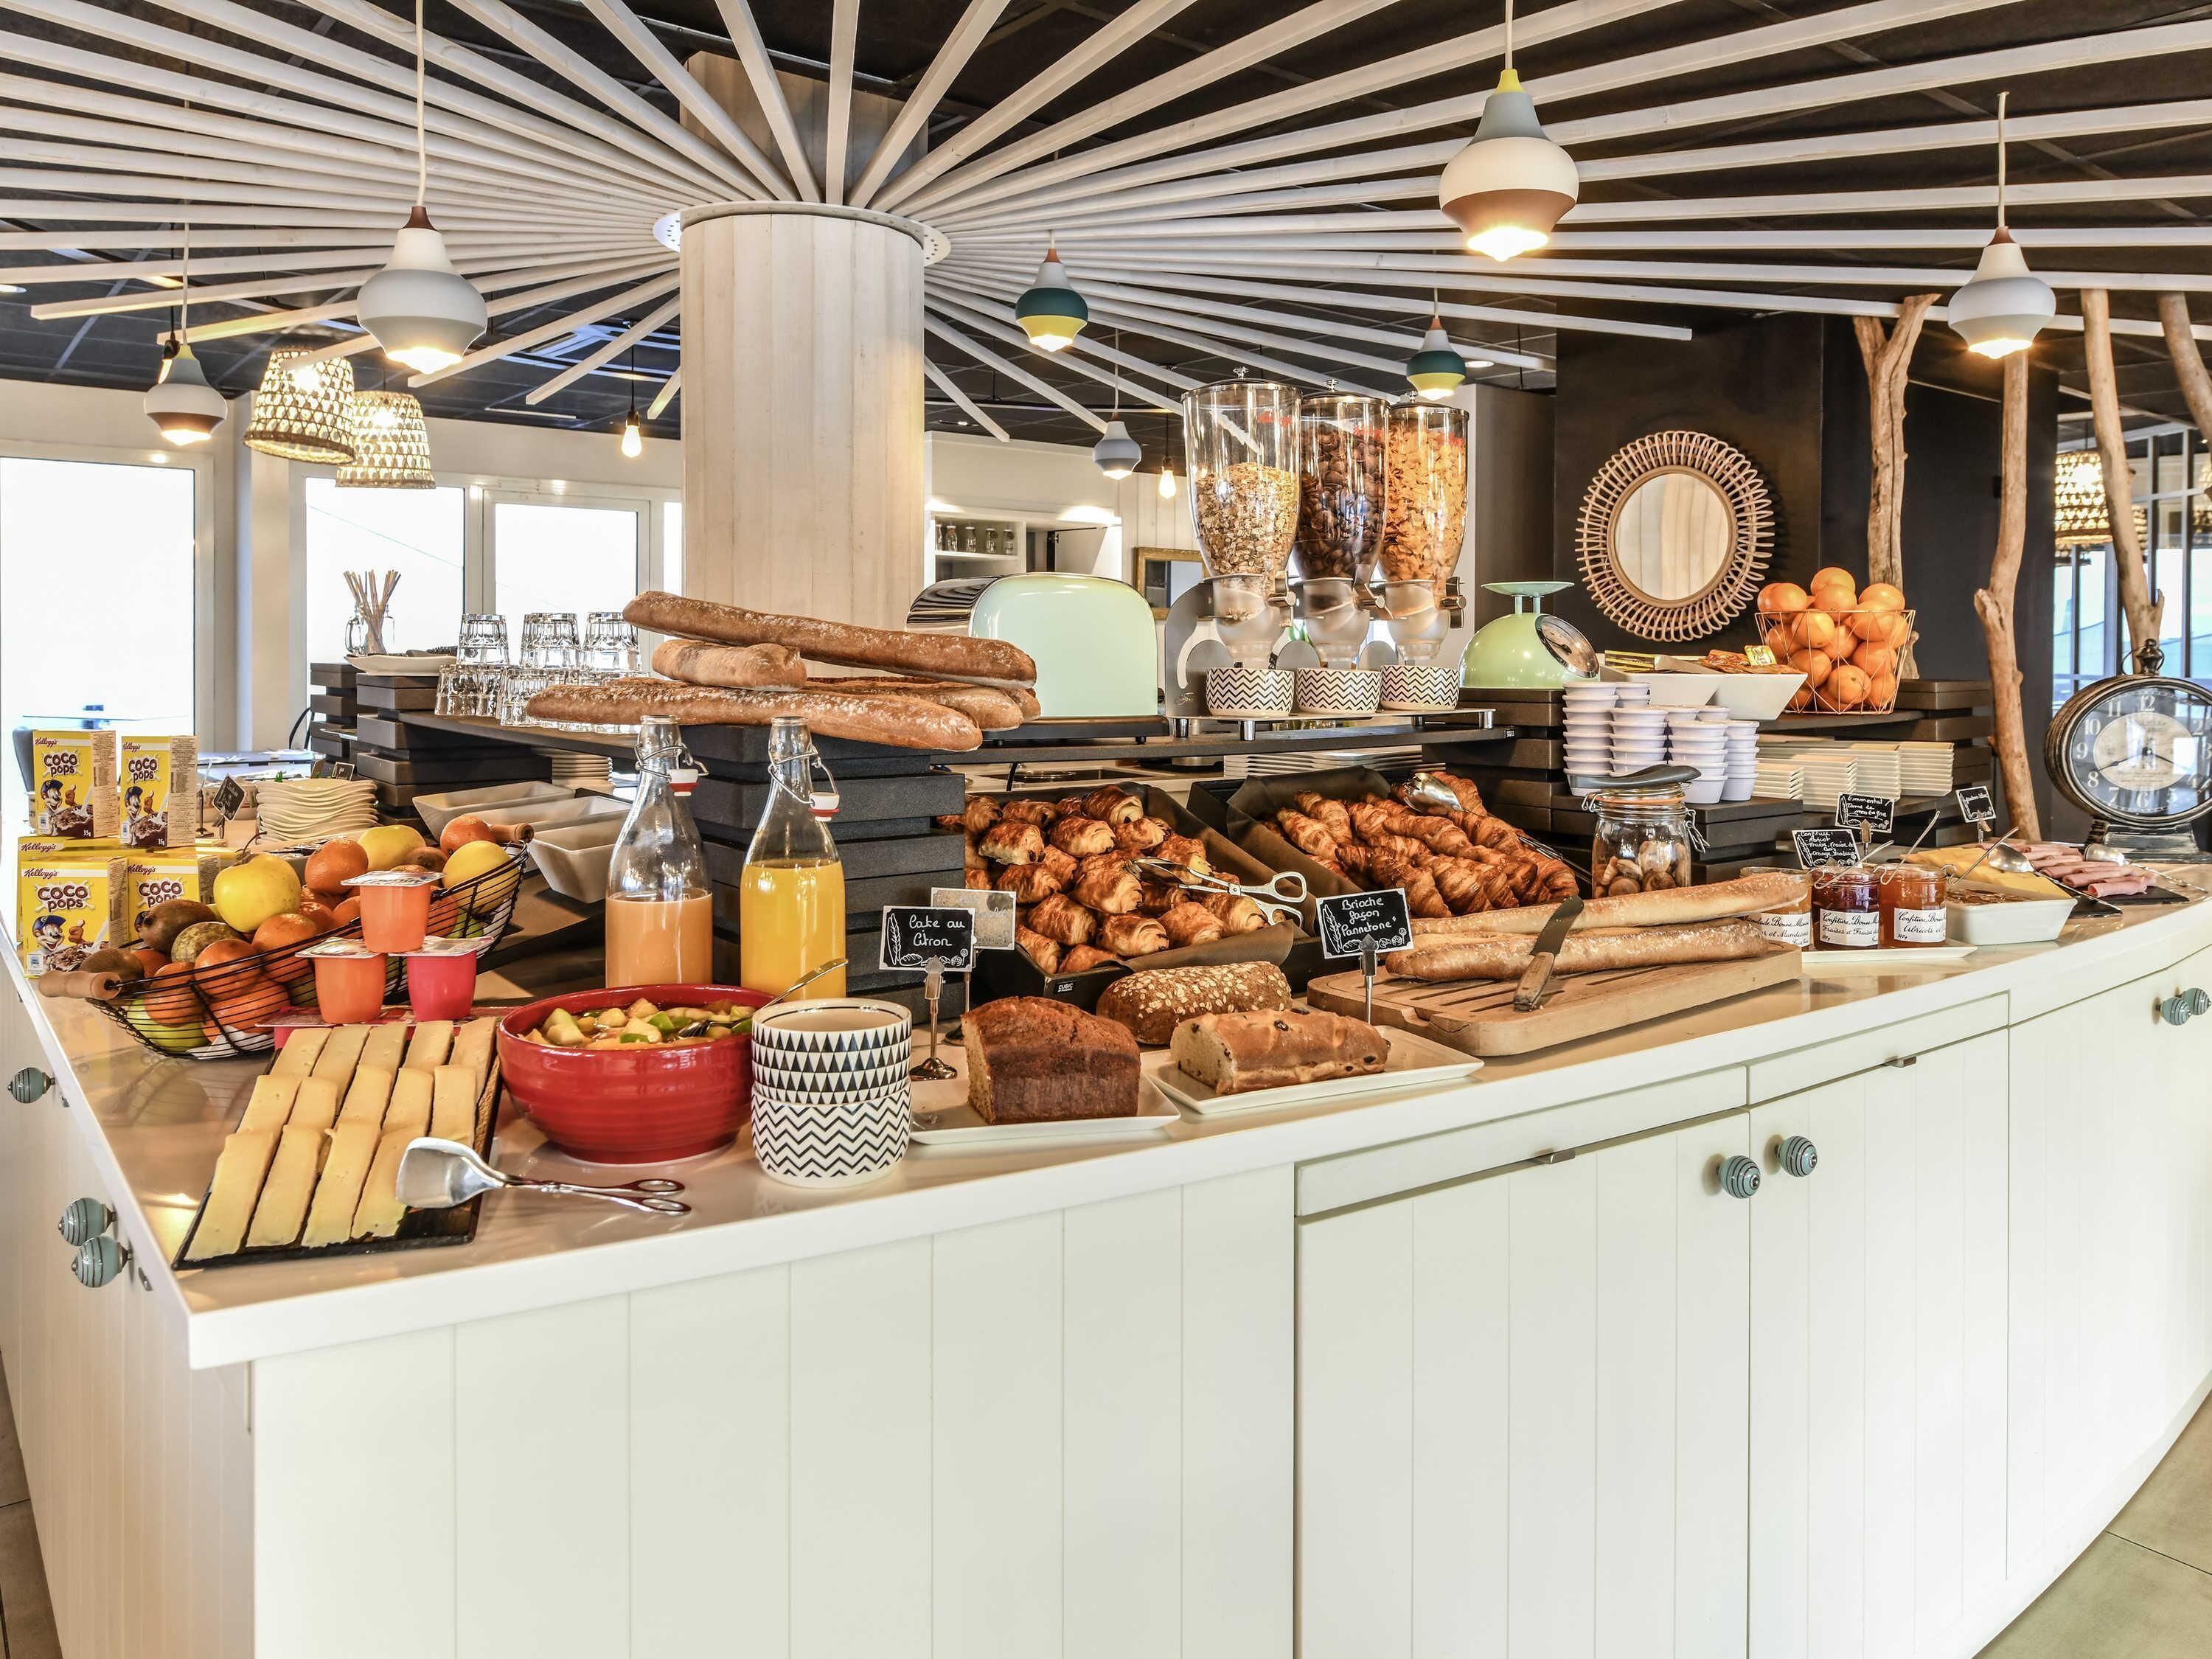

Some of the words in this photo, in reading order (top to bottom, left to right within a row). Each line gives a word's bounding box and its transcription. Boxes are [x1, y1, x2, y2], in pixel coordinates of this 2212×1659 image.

[2107, 700, 2121, 717] 11
[2139, 695, 2155, 712] 12
[2084, 718, 2101, 735] 10
[2192, 720, 2204, 736] 2
[35, 737, 58, 748] Kellogg's
[2076, 742, 2089, 759] 9
[50, 765, 75, 777] pops
[133, 771, 154, 783] pops
[2087, 771, 2099, 787] 8
[2109, 787, 2120, 805] 7
[2136, 791, 2149, 808] 6
[21, 843, 57, 852] Kellogg's
[24, 869, 58, 880] Kellogg's
[127, 864, 156, 875] Kellogg's
[47, 898, 84, 914] pops
[1341, 897, 1384, 911] Brioche
[909, 914, 941, 929] Cake
[947, 919, 966, 929] au
[1823, 912, 1850, 925] Confiture
[1899, 911, 1927, 923] Confiture
[913, 930, 953, 947] Citron
